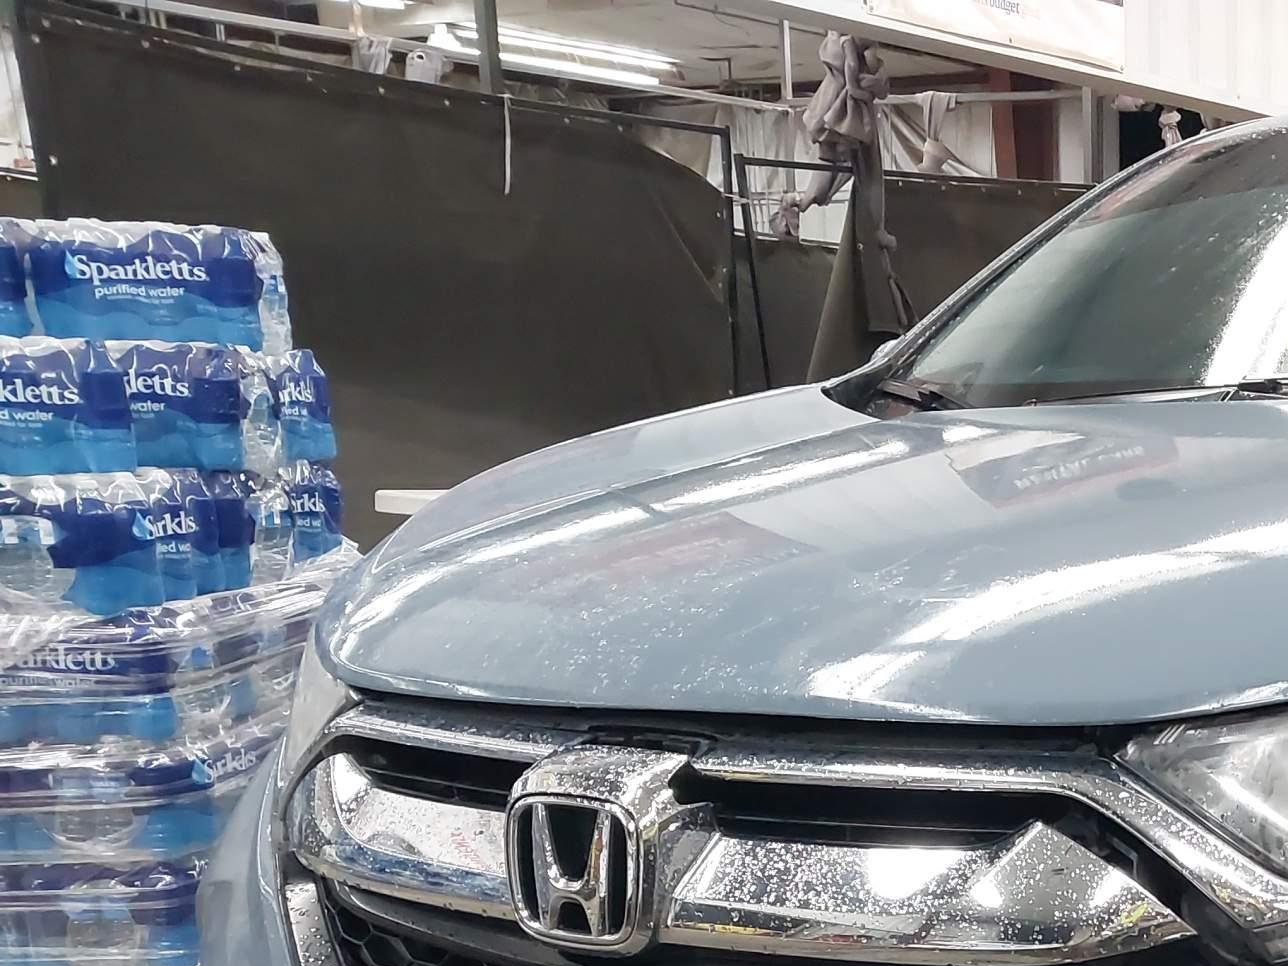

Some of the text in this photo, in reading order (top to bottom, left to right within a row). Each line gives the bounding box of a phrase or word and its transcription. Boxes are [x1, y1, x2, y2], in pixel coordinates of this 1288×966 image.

[73, 254, 209, 286] Sparkletts
[94, 284, 146, 299] purified
[148, 286, 186, 297] water
[13, 411, 55, 422] water
